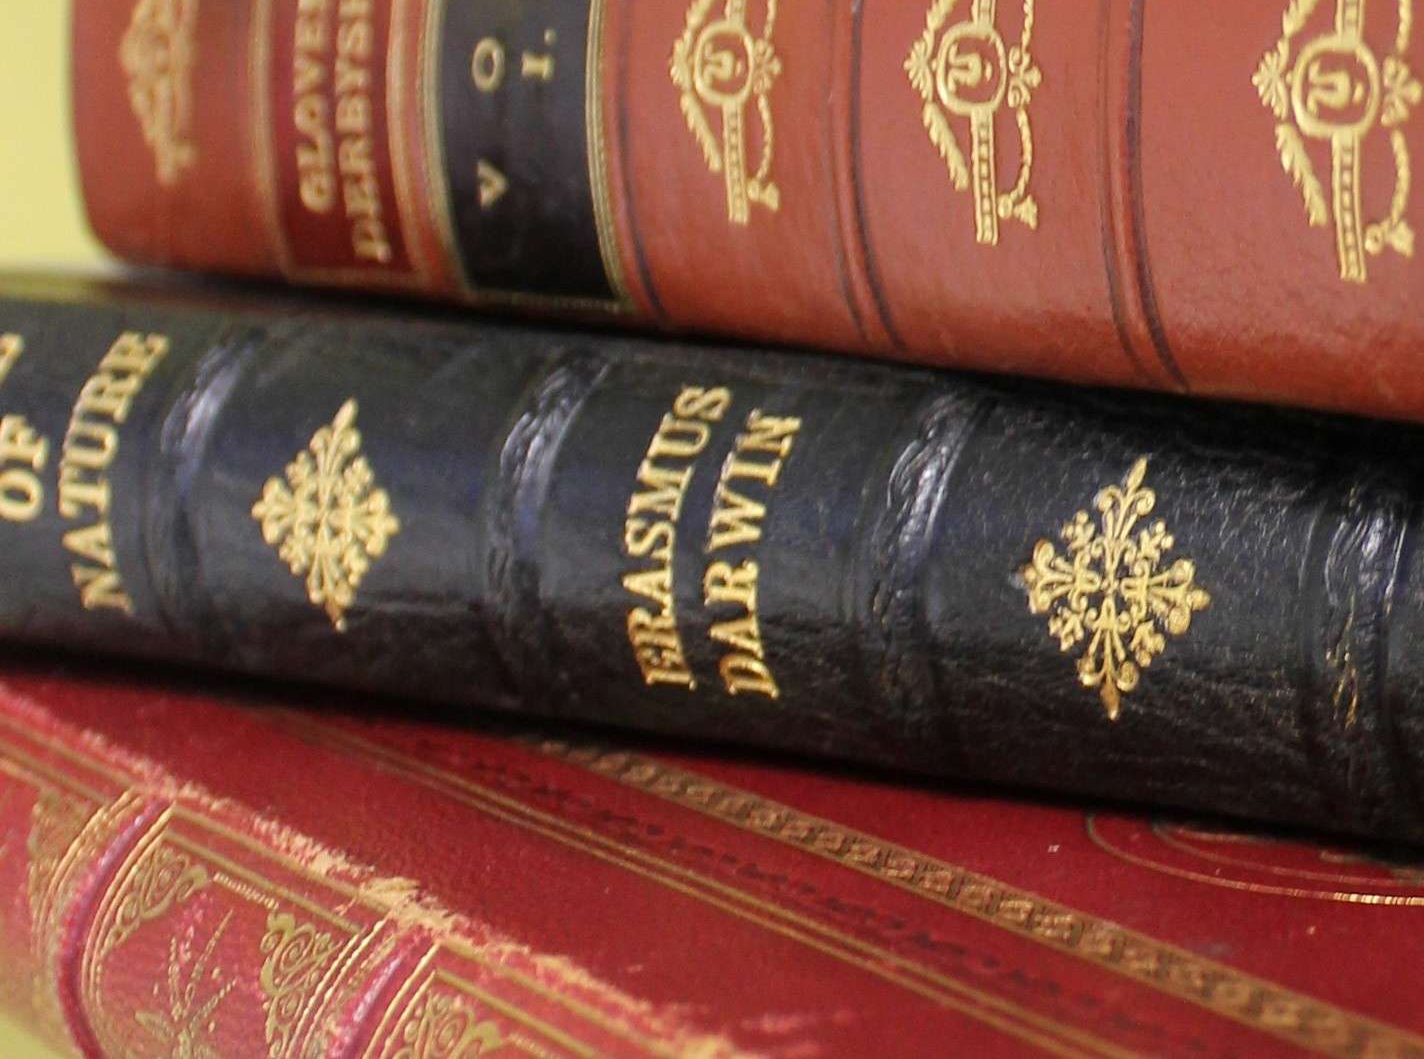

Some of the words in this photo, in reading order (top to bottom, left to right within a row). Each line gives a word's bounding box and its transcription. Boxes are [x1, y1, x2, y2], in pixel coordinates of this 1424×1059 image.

[0, 414, 49, 522] OF
[59, 331, 170, 615] NATURE
[622, 385, 732, 691] ERASMUS
[703, 407, 802, 699] DARWIN
